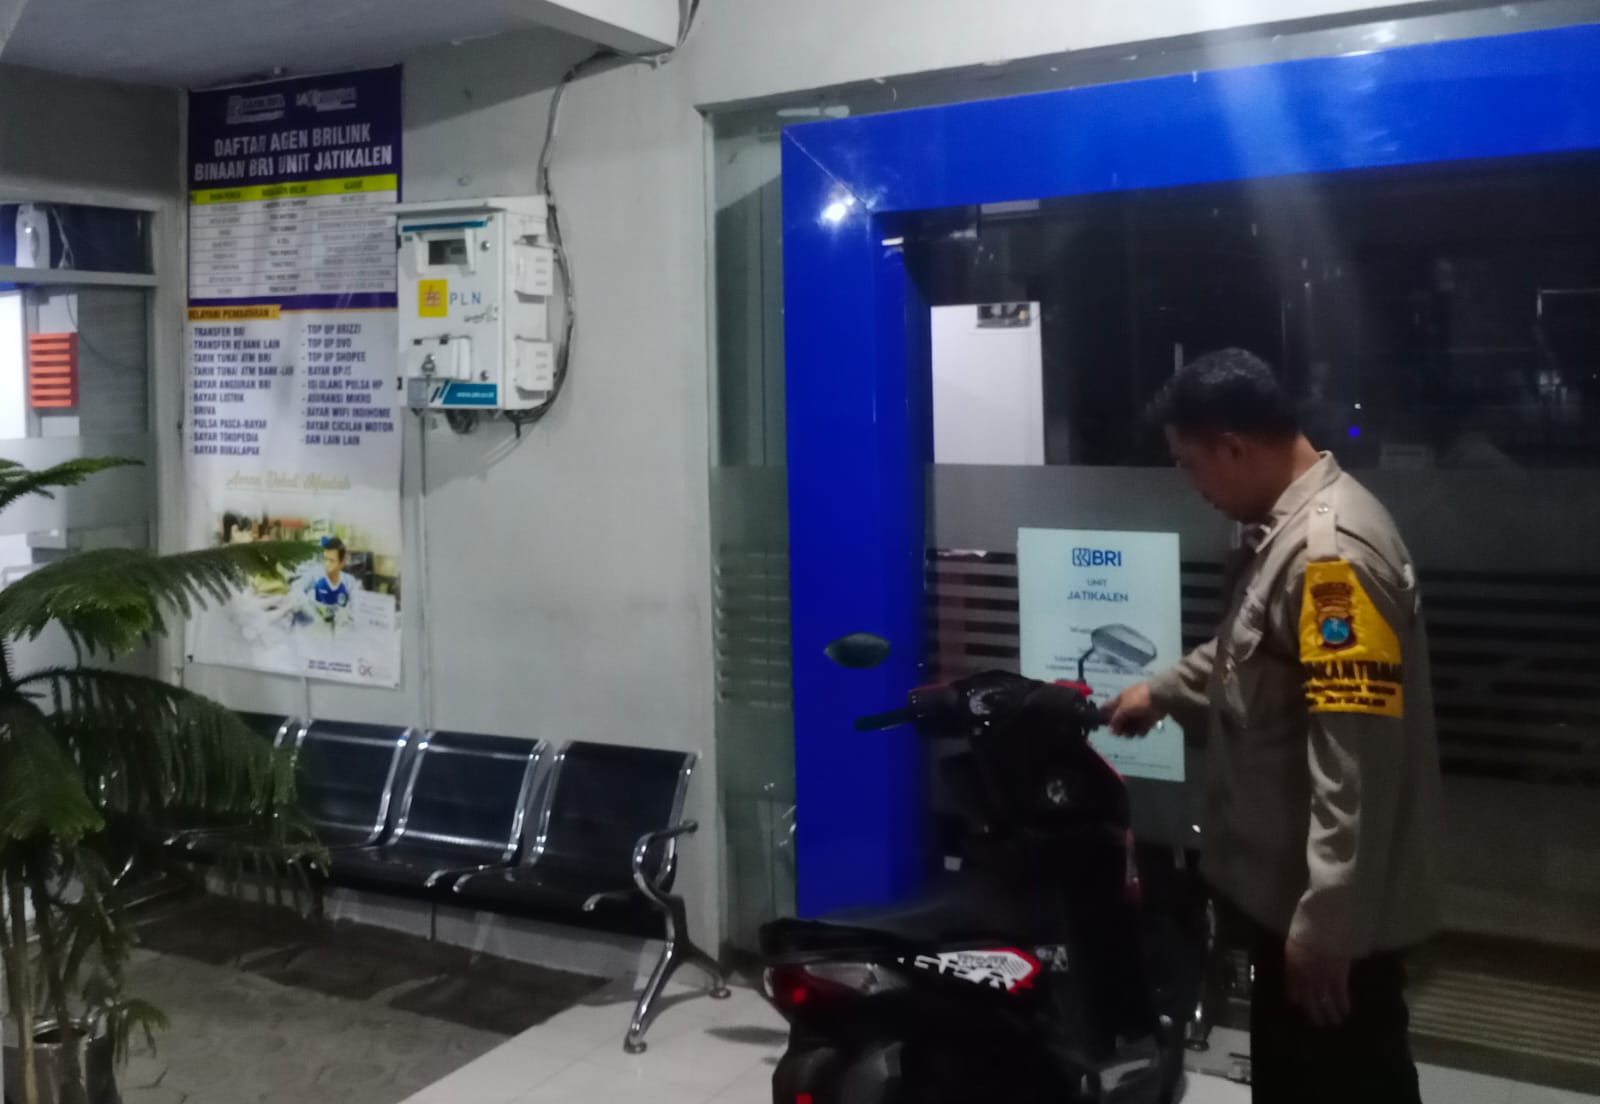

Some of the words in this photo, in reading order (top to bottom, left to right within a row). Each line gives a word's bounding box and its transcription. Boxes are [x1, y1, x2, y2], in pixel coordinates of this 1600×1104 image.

[214, 135, 267, 157] DAFTAR
[270, 129, 309, 152] AGEN
[312, 123, 371, 147] BRILINK
[194, 161, 246, 181] BINAAN
[250, 157, 274, 177] BRI
[278, 153, 311, 174] UNIT
[314, 145, 392, 171] JATIKALEN
[449, 291, 482, 306] PLN
[1091, 549, 1122, 567] BRI
[1086, 578, 1107, 588] UNIT
[1066, 590, 1129, 602] JATIKALEN
